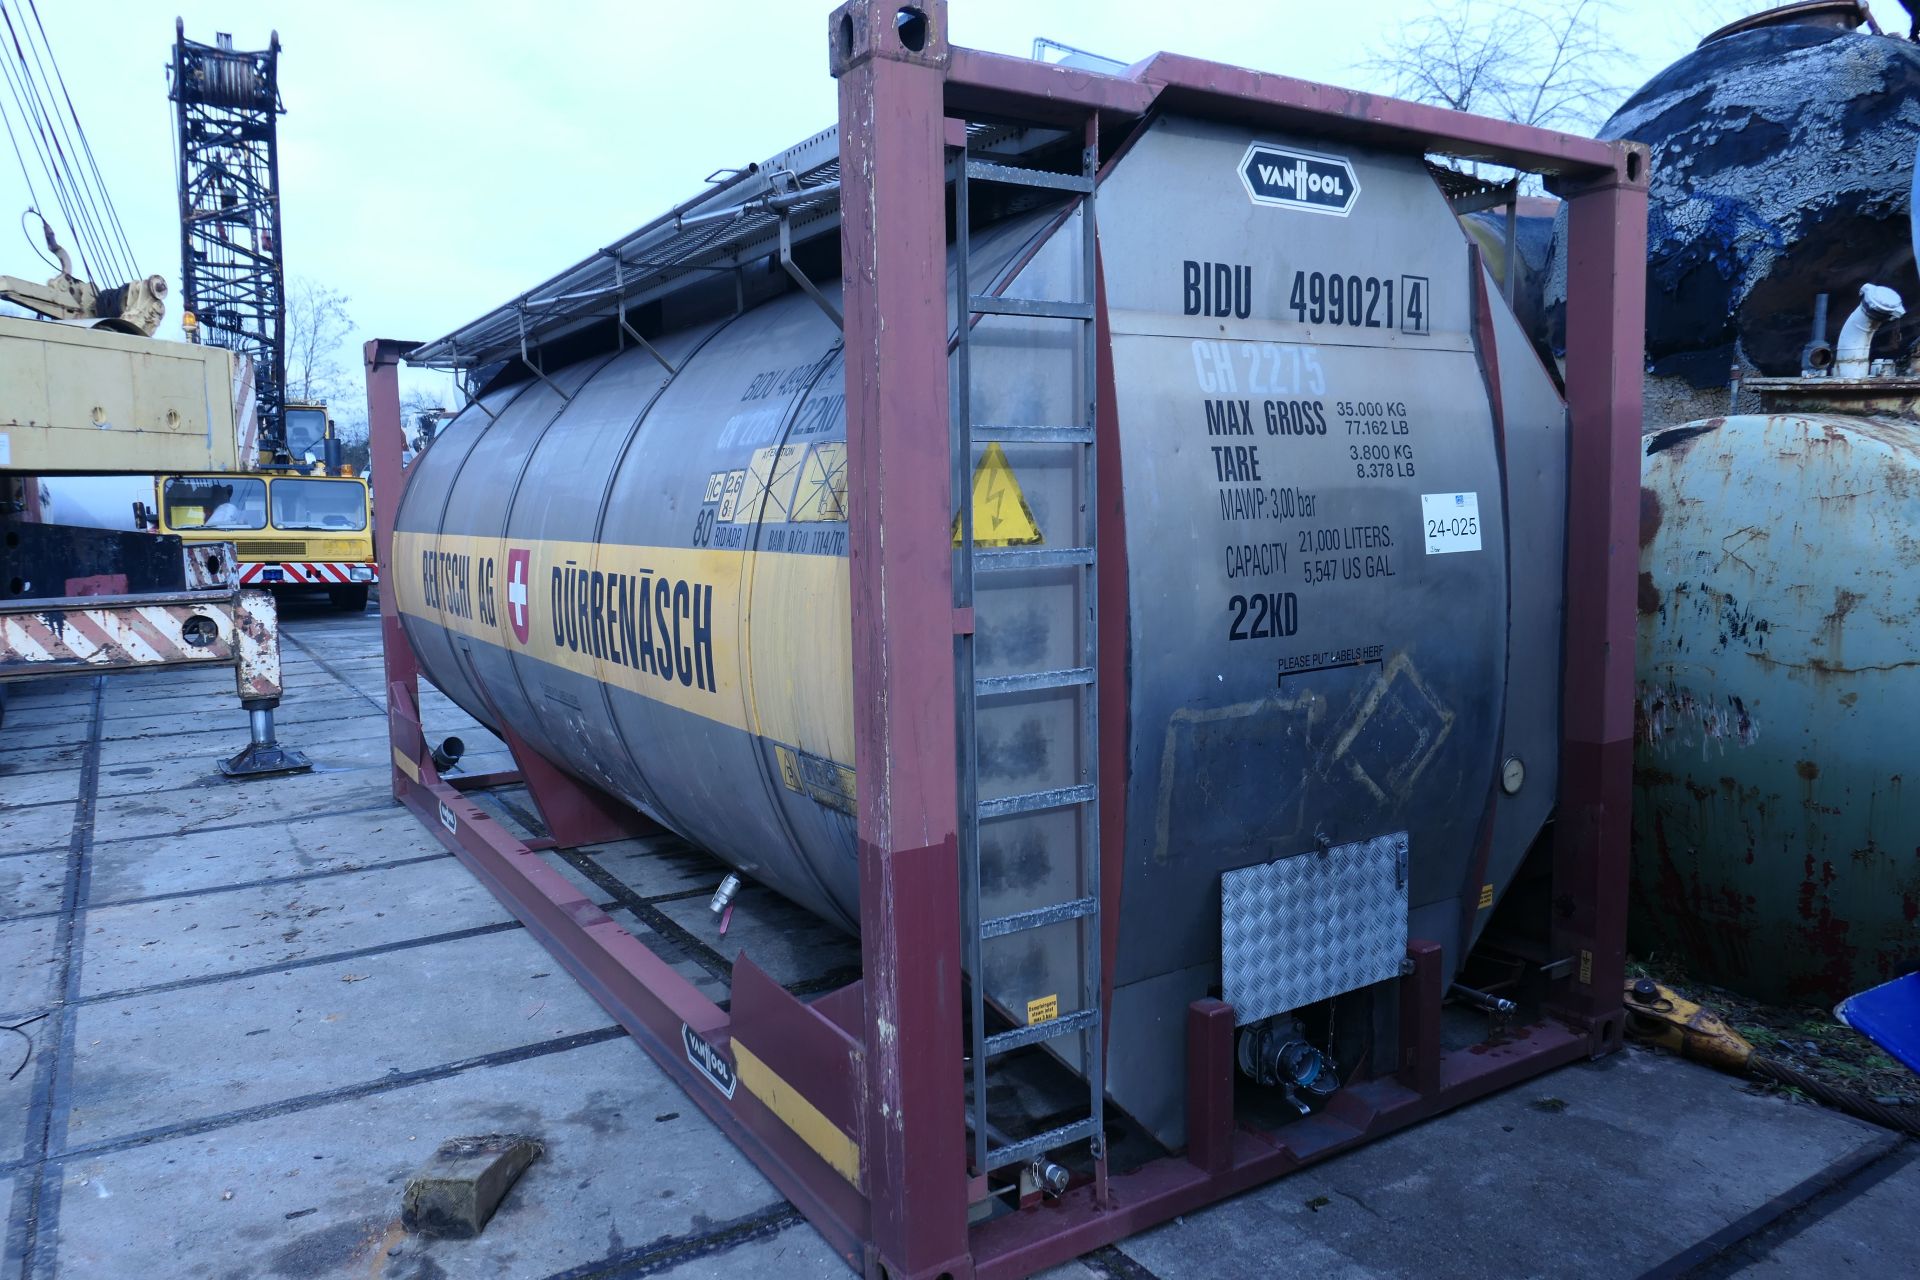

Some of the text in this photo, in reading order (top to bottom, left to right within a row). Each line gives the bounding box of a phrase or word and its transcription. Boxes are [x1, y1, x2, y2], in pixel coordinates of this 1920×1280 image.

[1183, 260, 1423, 331] BIDU 499021 4
[1191, 340, 1327, 396] CH 2275
[1204, 399, 1408, 437] MAX GROSS 35.000 KG
[1344, 419, 1410, 436] 77.162 LB
[1211, 444, 1414, 483] TARE 3.800 KG
[1356, 461, 1416, 479] 8.378 LB
[1271, 487, 1294, 524] 3,00
[1297, 486, 1317, 518] bar
[692, 507, 715, 548] 80
[1427, 517, 1478, 538] 24-025
[1225, 524, 1395, 579] CAPACITY 21,000 LITERS.
[1303, 554, 1397, 587] 5,547 US GAL.
[478, 557, 497, 628] AG
[1228, 591, 1298, 642] 22KD
[1278, 654, 1311, 671] PLEASE
[1331, 646, 1361, 663] LABELS
